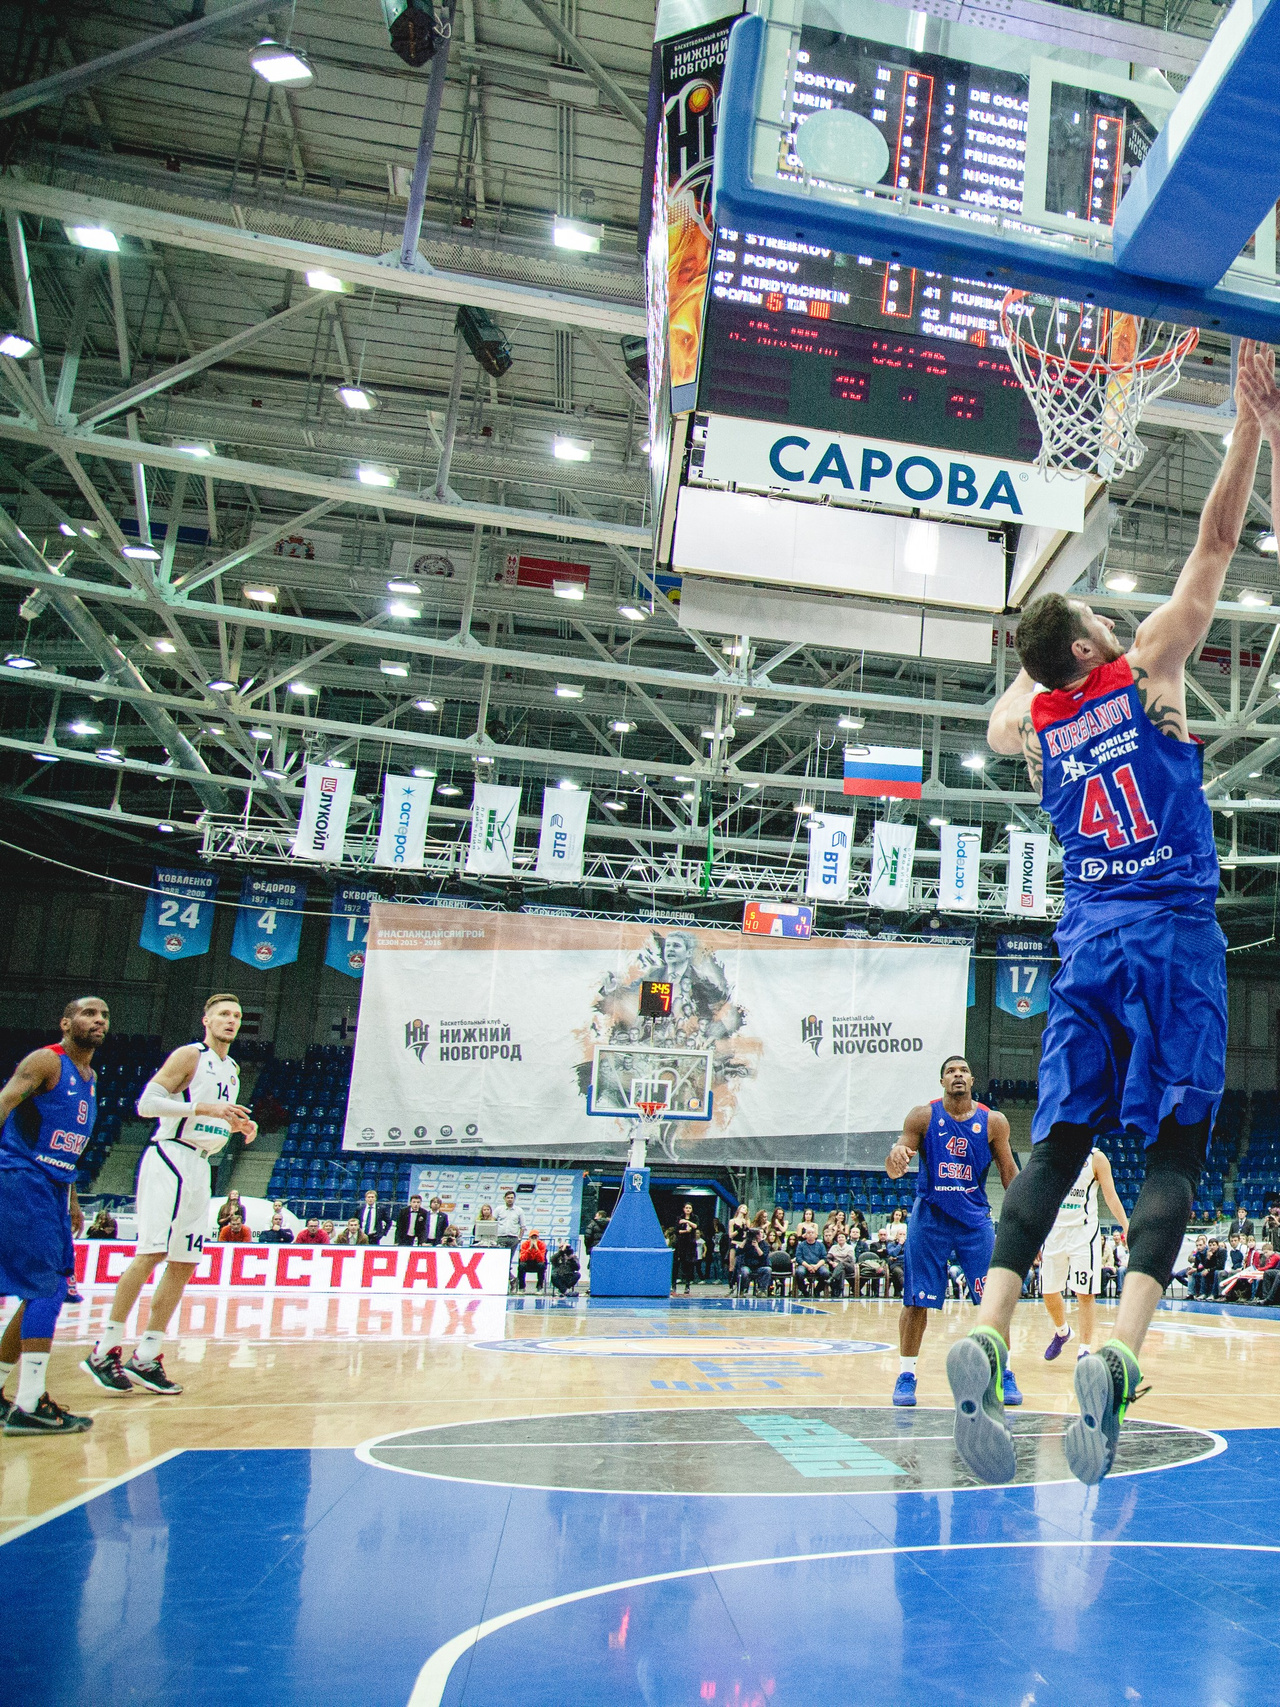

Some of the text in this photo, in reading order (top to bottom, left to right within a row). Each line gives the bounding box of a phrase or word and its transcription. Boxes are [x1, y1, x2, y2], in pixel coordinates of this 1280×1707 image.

[675, 38, 728, 66] НИЖНИЙ
[966, 129, 1027, 152] TEODOS
[962, 169, 1025, 192] NICHOLS
[743, 252, 800, 274] POPOV
[713, 270, 850, 305] 47 KIRDYACHKIN
[949, 311, 998, 331] HINES
[769, 435, 1024, 516] САРОВА
[1045, 693, 1133, 758] KURBANOV
[1089, 728, 1140, 757] NORILSK
[1097, 741, 1140, 765] NICKEL
[1078, 762, 1159, 851] 41
[312, 792, 333, 850] ЛУКОЙЛ
[393, 801, 412, 863] астерос
[822, 850, 839, 885] ВТБ
[954, 832, 966, 888] астеро
[1022, 842, 1035, 894] ЛУКОЙЛ
[158, 873, 213, 887] КОВАЛЕНКО
[252, 880, 296, 894] ФЁДОРОВ
[158, 900, 200, 929] 24
[257, 906, 277, 935] 4
[745, 919, 759, 930] 40
[378, 929, 485, 938] #НАСЛАЖДАЙСЯИГРОЙ
[1007, 940, 1043, 951] ФЕДОТОВ
[1010, 966, 1039, 994] 17
[660, 995, 670, 1011] 7
[440, 1023, 511, 1043] НИЖНИЙ
[832, 1022, 893, 1038] NIZHNY
[440, 1044, 522, 1061] НОВГОРОД
[833, 1038, 924, 1055] NOVGOROD
[217, 1081, 229, 1101] 14
[76, 1100, 88, 1125] 9
[194, 1123, 230, 1137] СИБУ
[50, 1130, 90, 1154] CSK
[946, 1136, 968, 1157] 42
[36, 1154, 76, 1171] AEROFLO
[938, 1162, 973, 1181] CSKA
[1070, 1188, 1085, 1197] GOROD
[185, 1233, 203, 1252] 14
[73, 1244, 485, 1289] СОССТРАХ
[1074, 1271, 1088, 1286] 13
